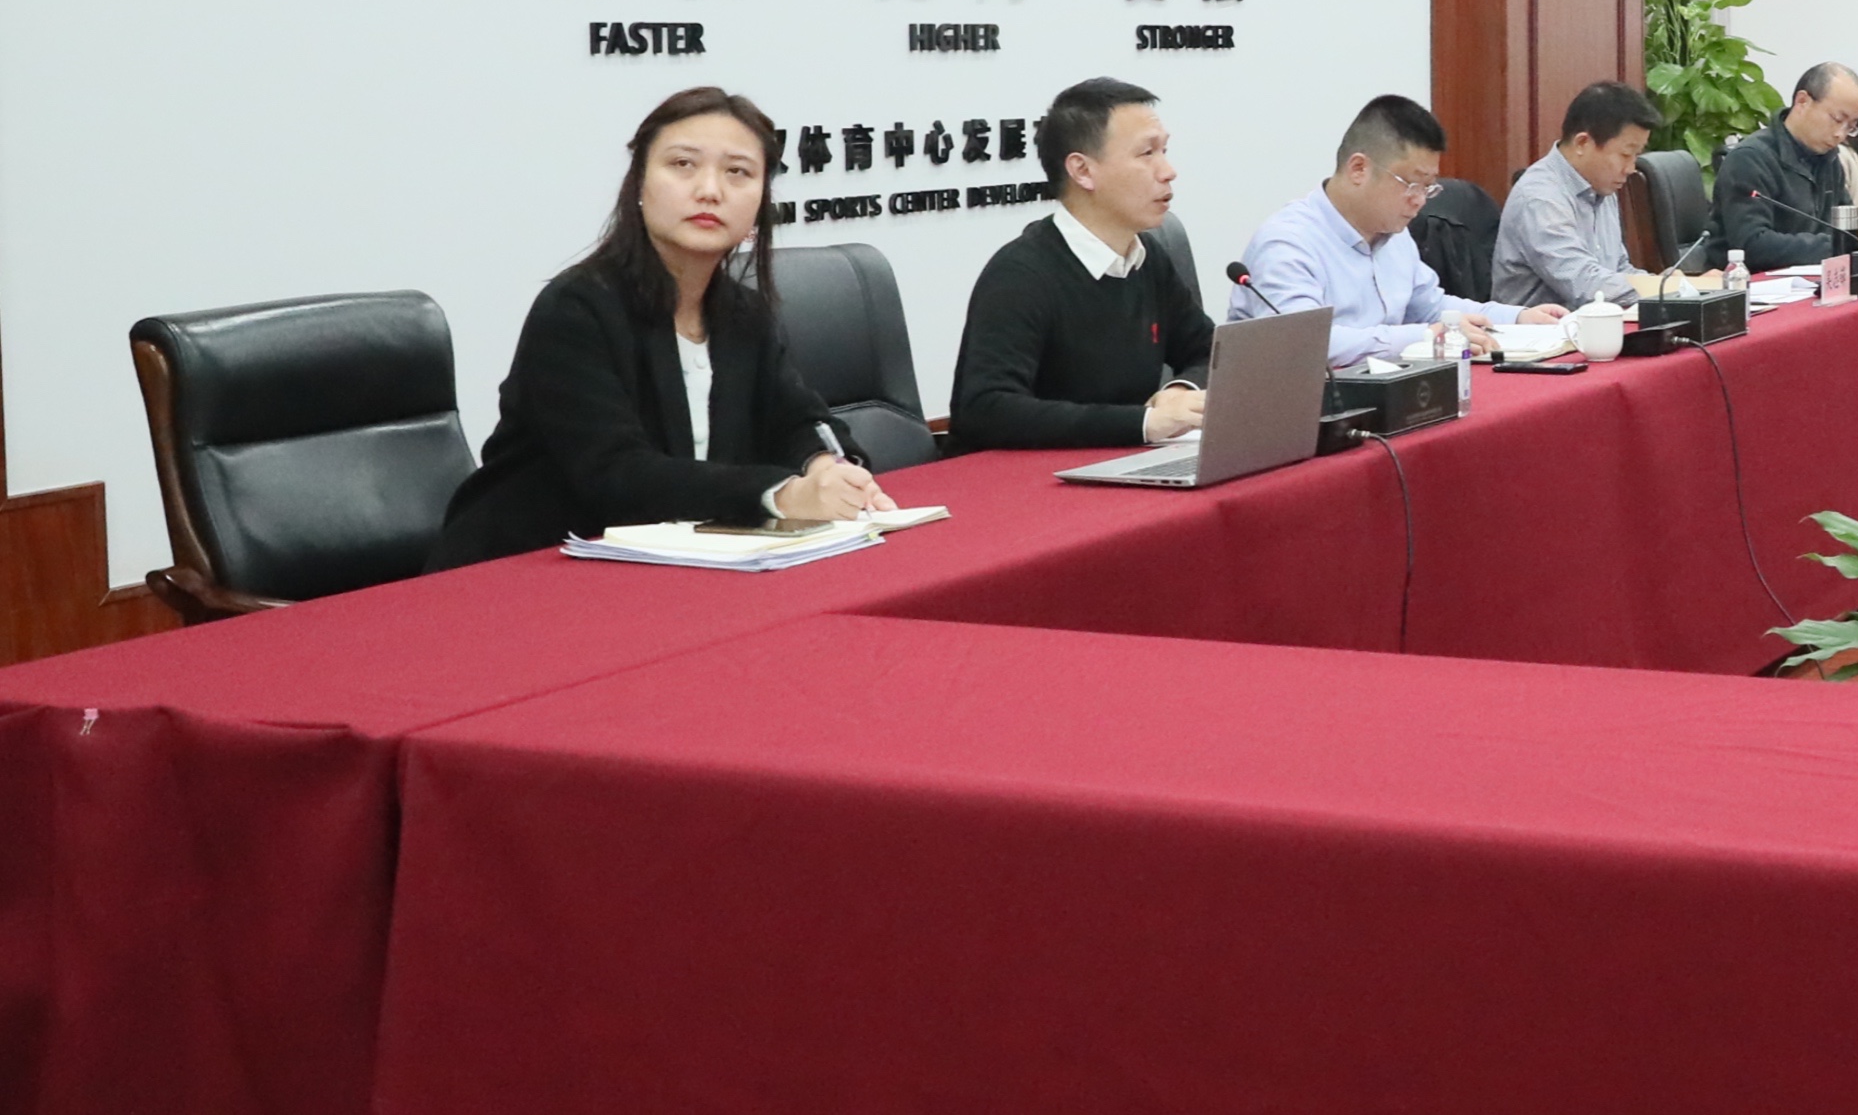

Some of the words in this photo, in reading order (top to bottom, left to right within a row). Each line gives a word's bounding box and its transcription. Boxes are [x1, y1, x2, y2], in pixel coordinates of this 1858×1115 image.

[589, 22, 706, 55] FASTER
[909, 23, 1000, 52] HIGHER
[1136, 25, 1235, 50] STRONGER
[774, 115, 1047, 174] 体育中心发展
[804, 194, 882, 223] SPORTS
[888, 188, 961, 215] CENTER
